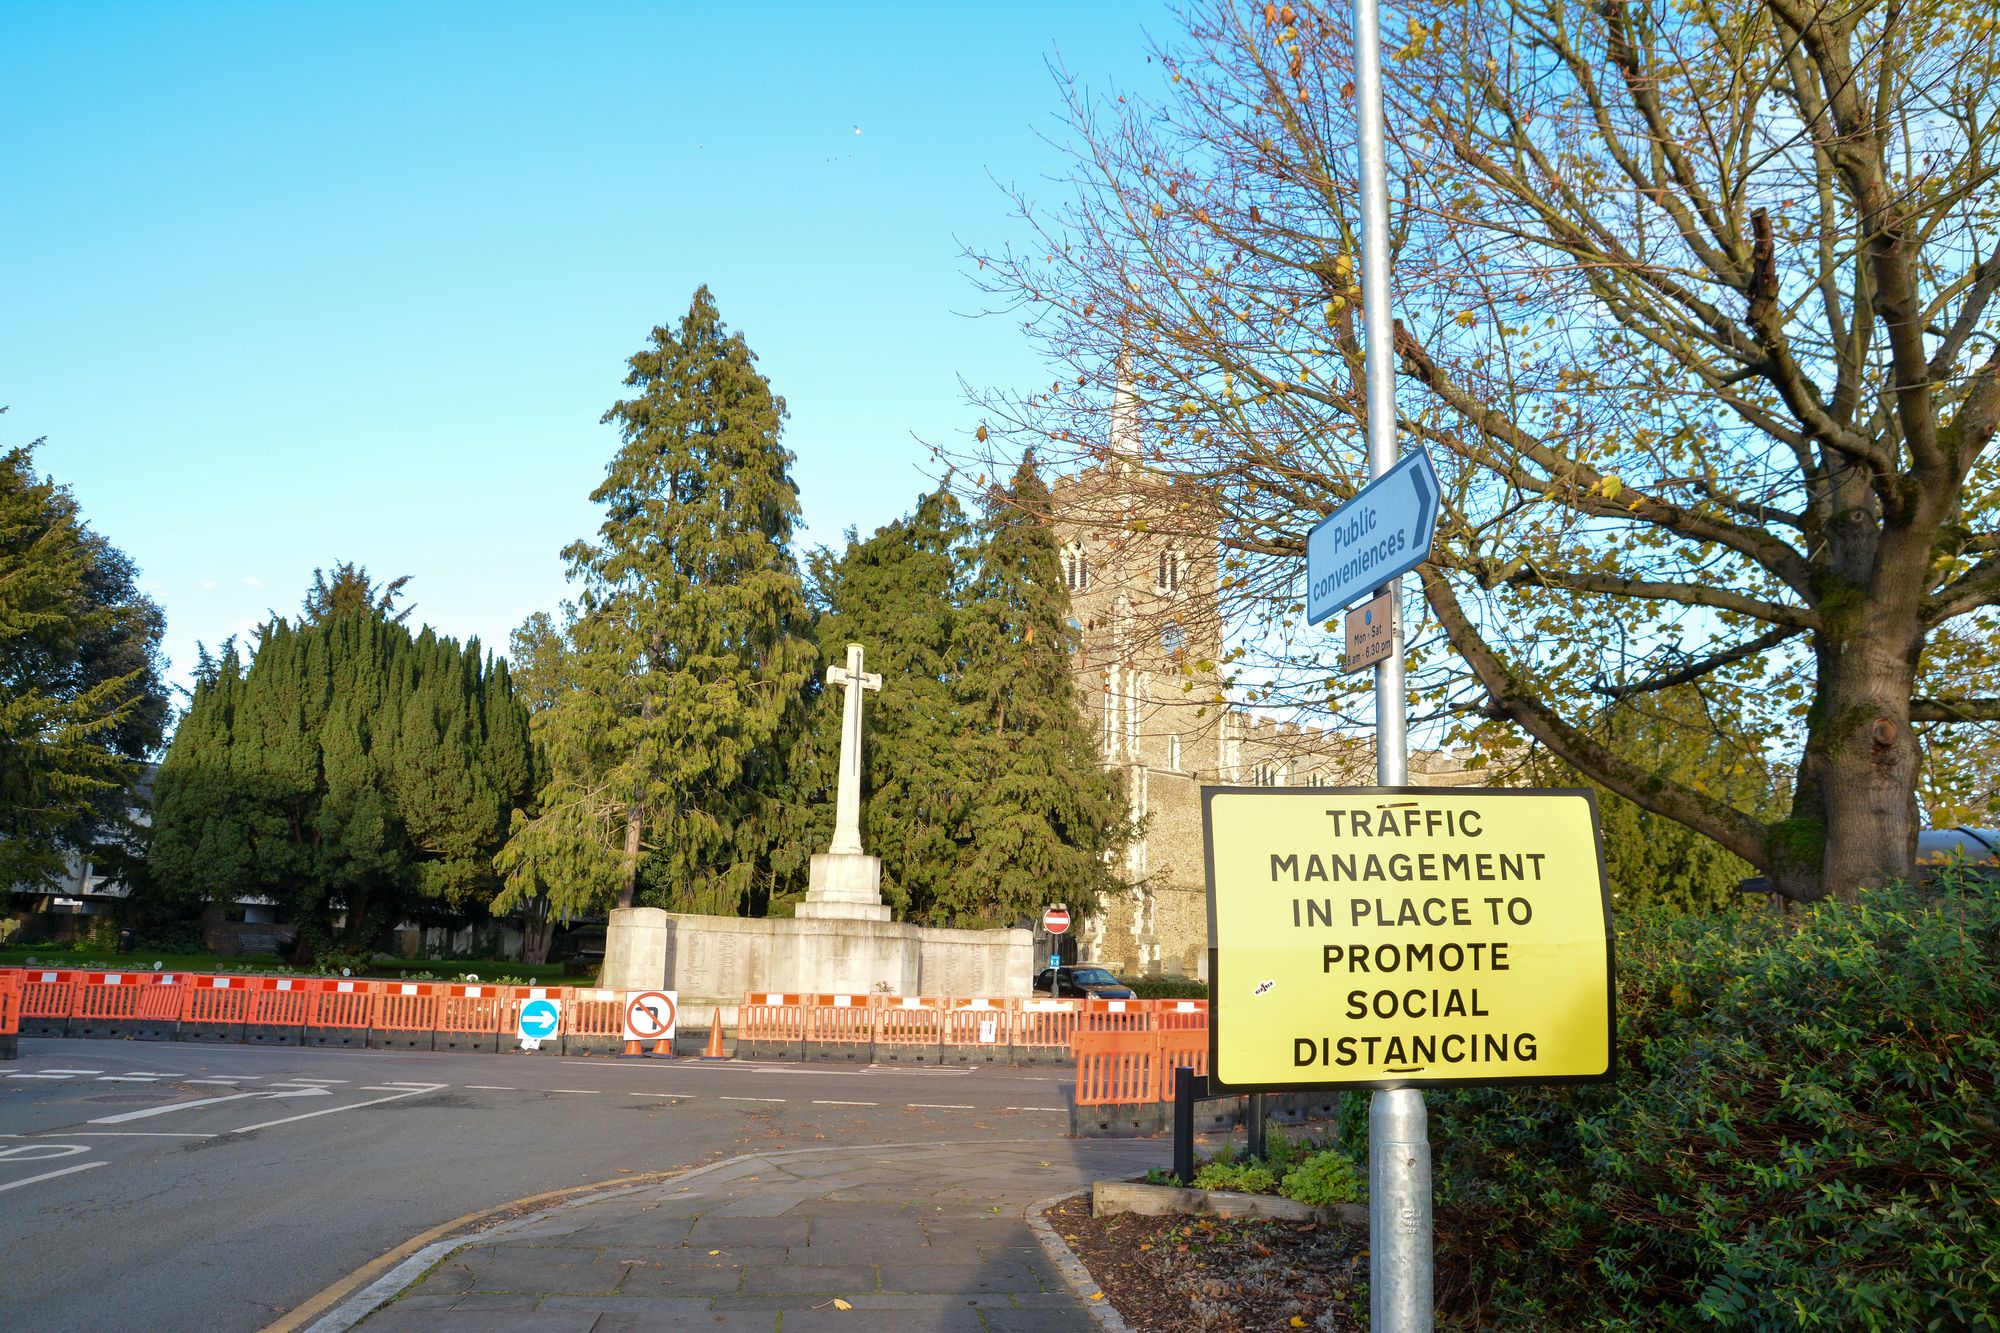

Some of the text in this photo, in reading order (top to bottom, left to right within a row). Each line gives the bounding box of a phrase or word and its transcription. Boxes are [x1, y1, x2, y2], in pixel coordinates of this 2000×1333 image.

[1334, 507, 1377, 554] Public
[1313, 528, 1405, 602] conveniences
[1354, 633, 1367, 646] Mon
[1371, 623, 1382, 638] Sat
[1365, 641, 1380, 658] 6.30
[1381, 639, 1391, 653] pm
[1326, 809, 1483, 837] TRAFFIC
[1271, 853, 1546, 881] MANAGEMENT
[1292, 897, 1533, 926] IN PLACE TO
[1324, 942, 1510, 973] PROMOTE
[1344, 988, 1489, 1020] SOCIAL
[1294, 1033, 1538, 1067] DISTANCING
